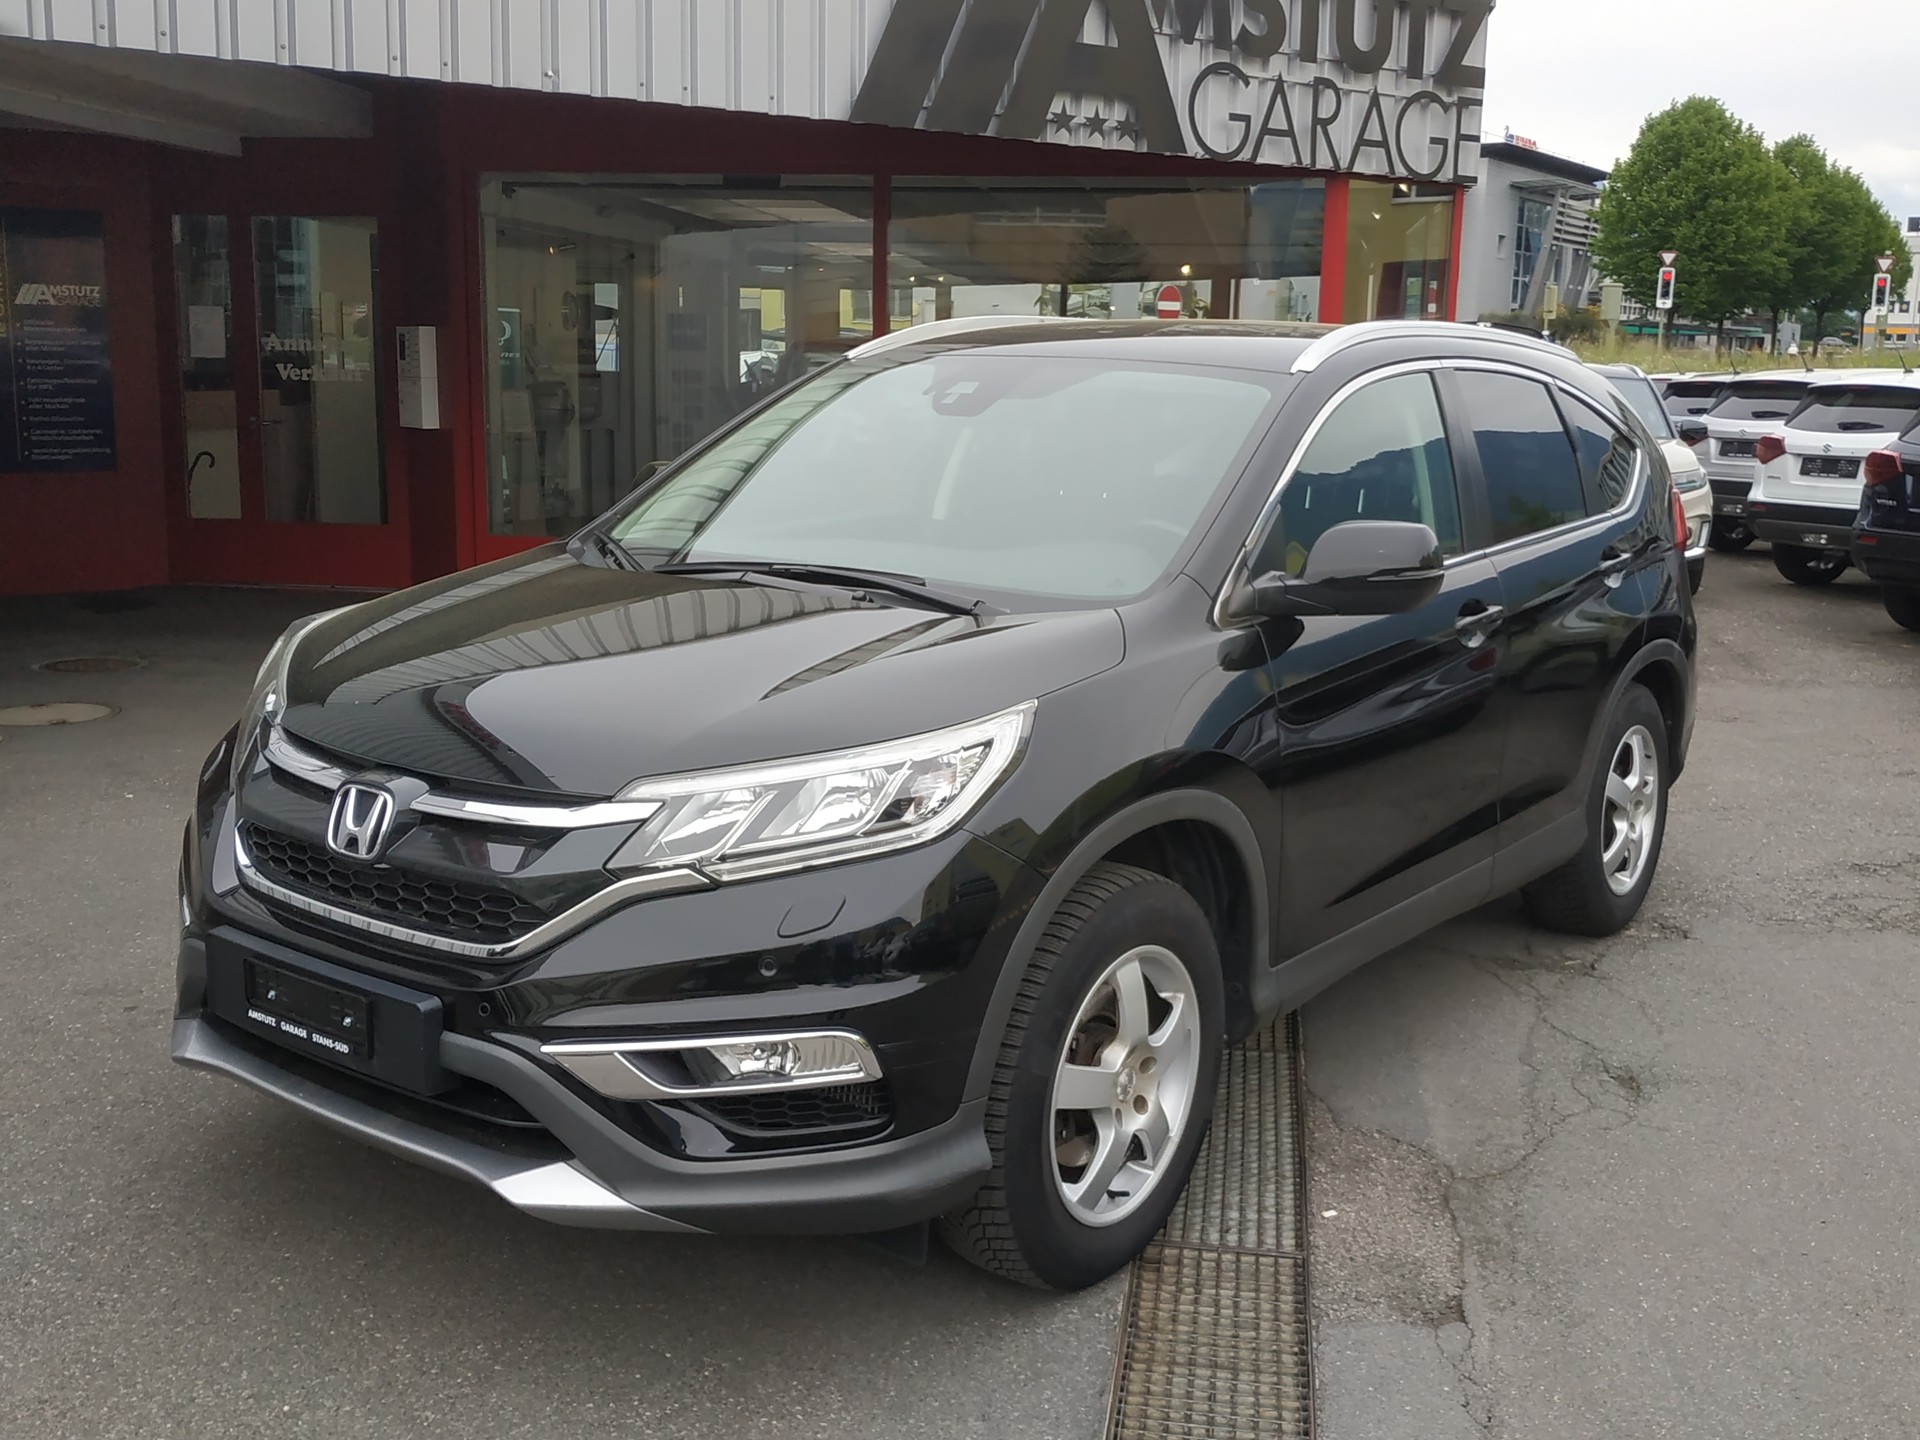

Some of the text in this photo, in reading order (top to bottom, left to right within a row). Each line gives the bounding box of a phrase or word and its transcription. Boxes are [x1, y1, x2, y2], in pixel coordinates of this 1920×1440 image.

[1188, 62, 1483, 184] GARAGE
[33, 284, 101, 305] AMSTUTZ
[248, 1009, 276, 1027] AMSTUTZ
[280, 1021, 307, 1039] GARAGE
